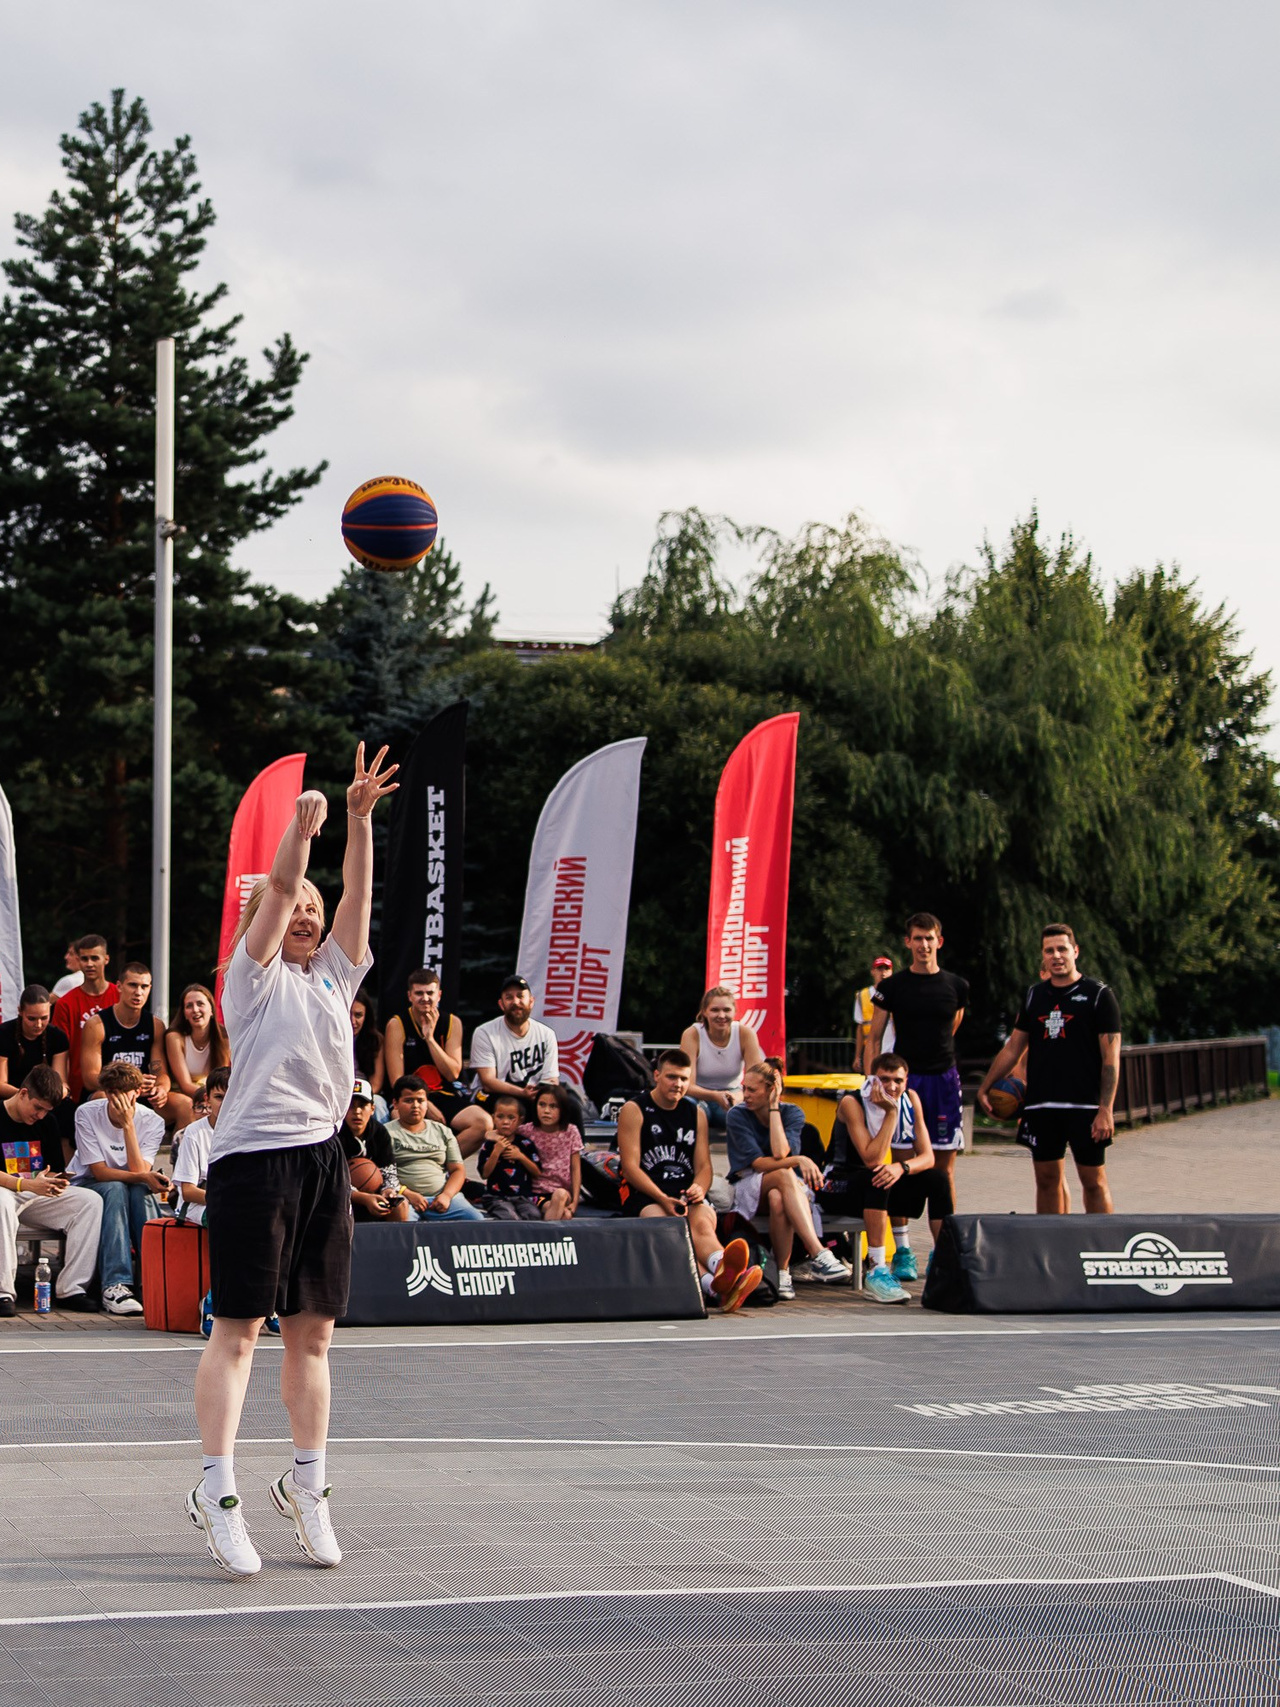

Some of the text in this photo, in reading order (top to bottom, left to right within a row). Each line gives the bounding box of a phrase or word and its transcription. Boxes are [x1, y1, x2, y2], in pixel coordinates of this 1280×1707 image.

[543, 855, 587, 1018] МОСКОВСКИЙ
[742, 921, 770, 999] СПОРТ
[575, 943, 611, 1020] СПОРТ
[676, 1127, 695, 1146] 14
[451, 1236, 579, 1269] МОСКОВСКИЙ
[1082, 1260, 1229, 1276] STREETBASKET
[456, 1271, 516, 1297] СПОРТ
